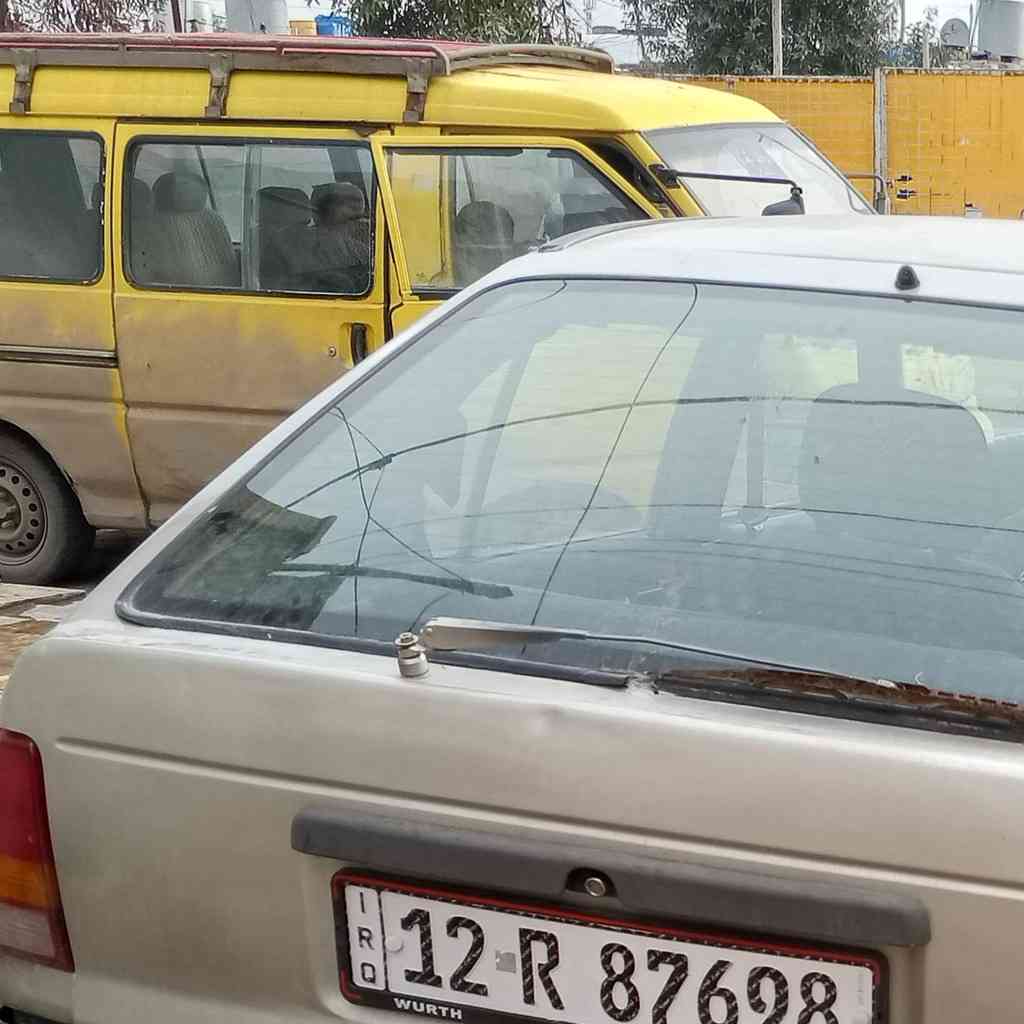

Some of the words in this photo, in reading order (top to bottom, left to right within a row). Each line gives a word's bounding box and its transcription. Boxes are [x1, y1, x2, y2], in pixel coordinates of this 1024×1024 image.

[357, 891, 377, 984] IRQ
[400, 908, 489, 997] 12
[518, 927, 565, 1011] R
[393, 997, 463, 1020] WURTH
